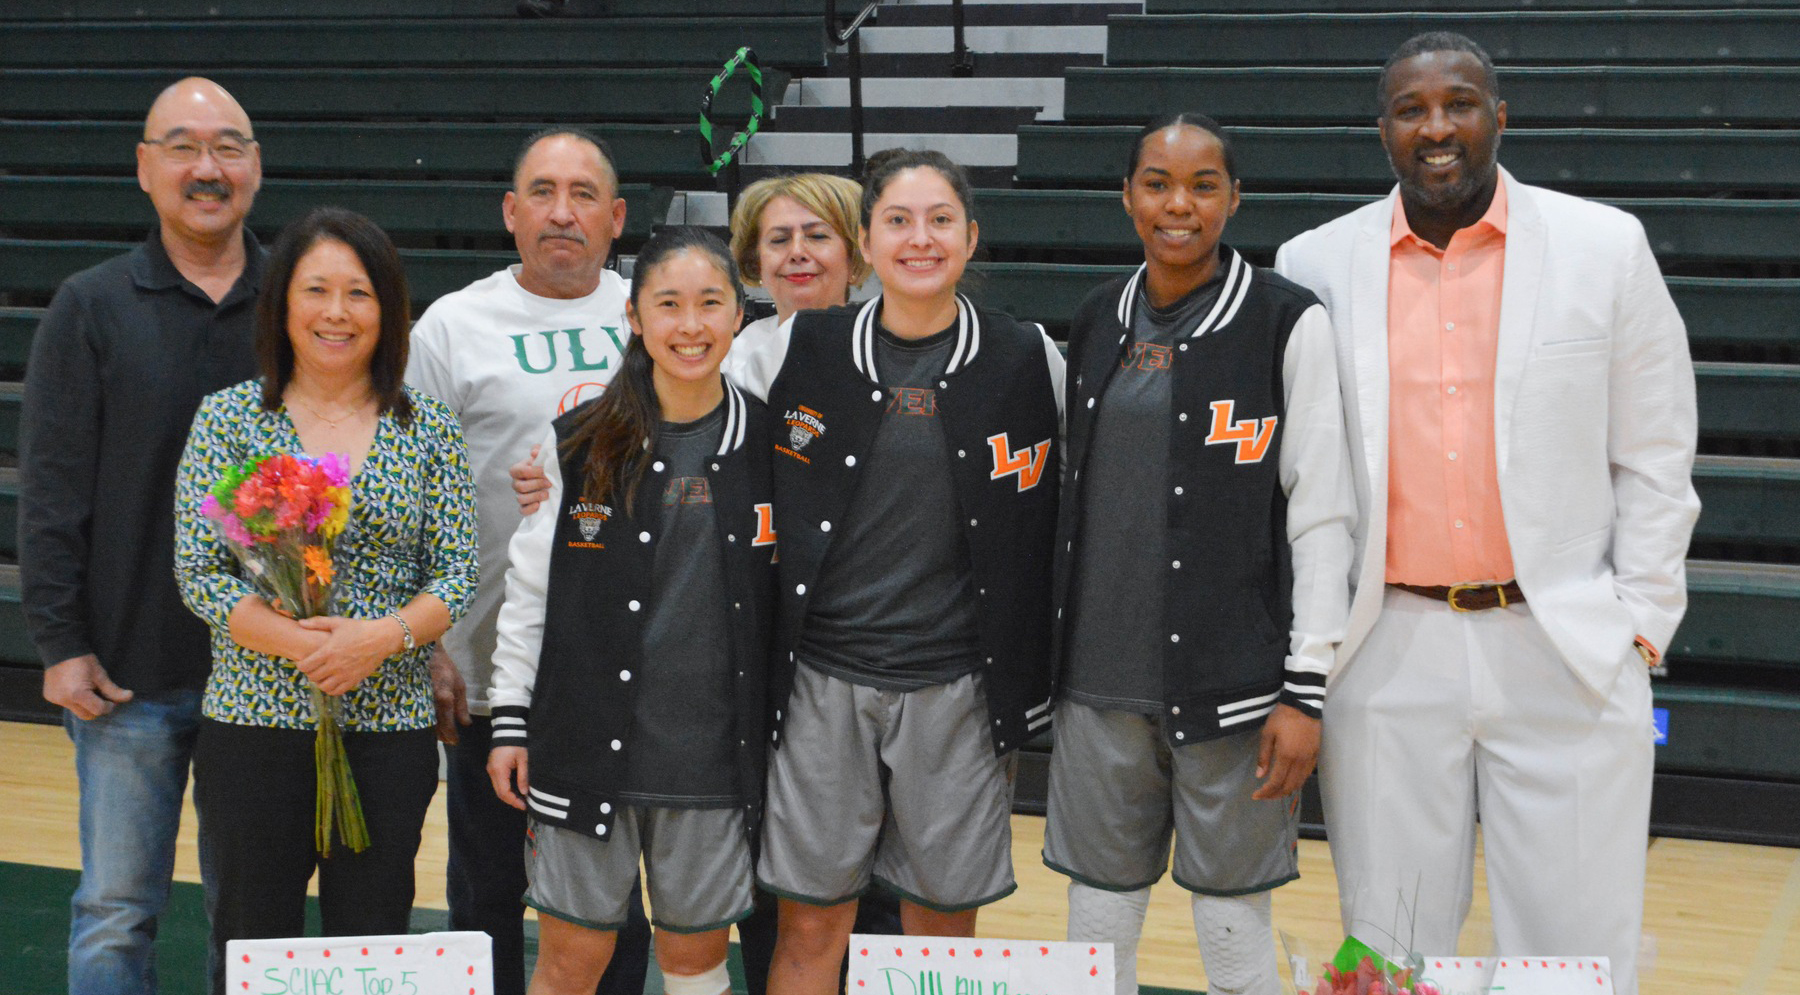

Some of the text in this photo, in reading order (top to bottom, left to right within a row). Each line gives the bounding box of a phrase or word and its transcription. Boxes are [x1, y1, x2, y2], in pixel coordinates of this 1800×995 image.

[775, 444, 810, 463] BASKETBALL
[1205, 400, 1278, 464] LV
[987, 432, 1051, 492] LV
[567, 541, 606, 549] BASKETBALL
[751, 502, 779, 565] L
[261, 966, 419, 995] SCIAC Top 5
